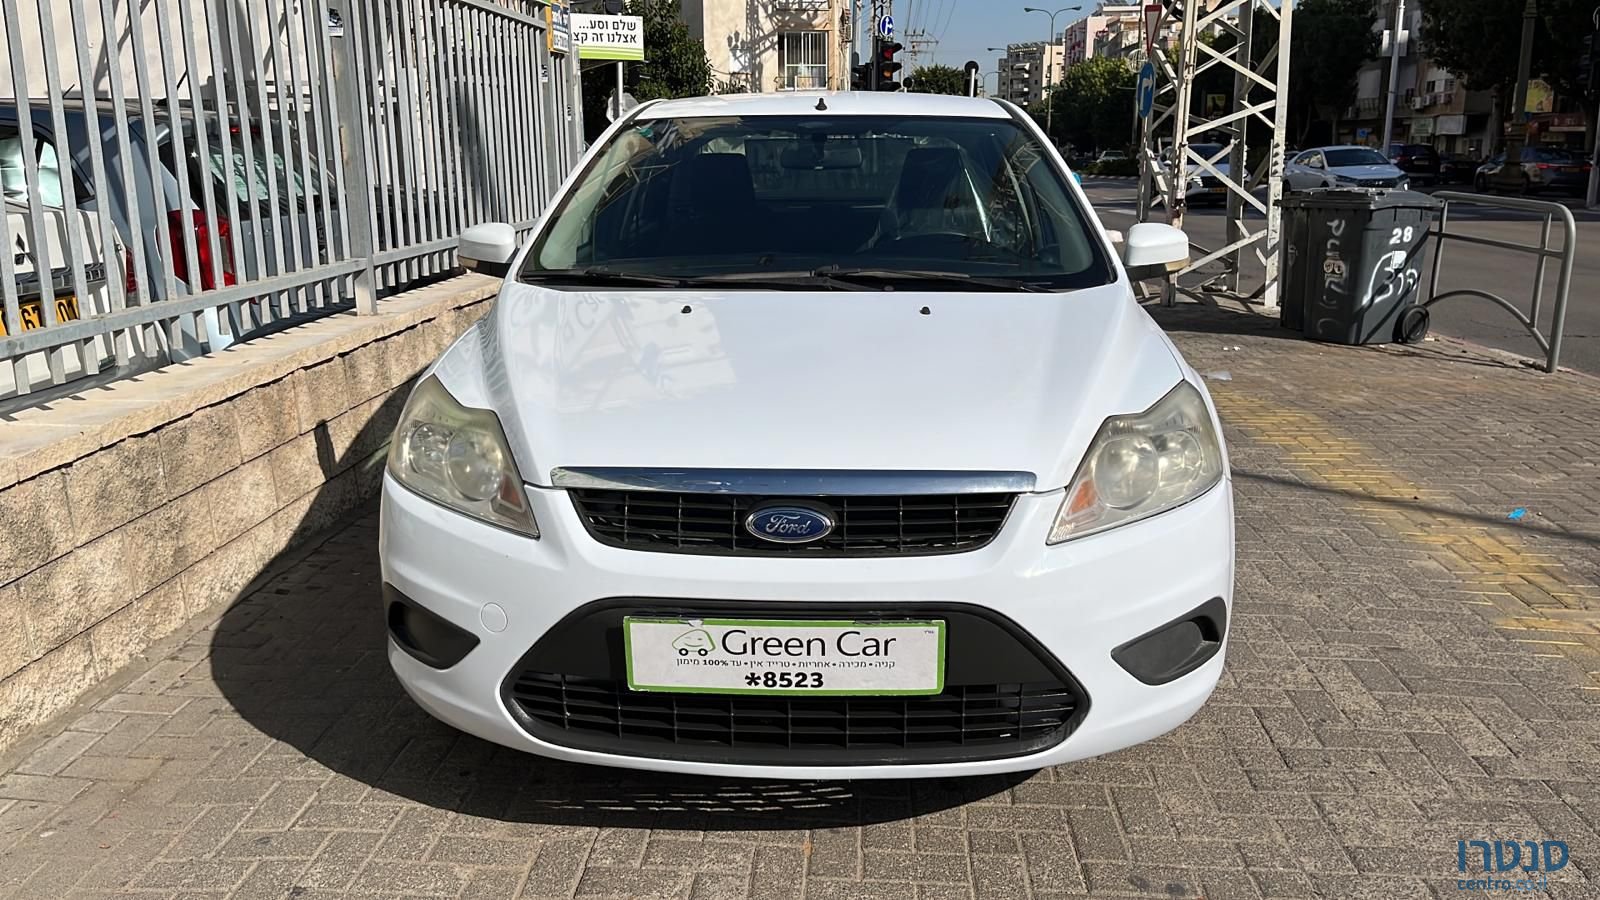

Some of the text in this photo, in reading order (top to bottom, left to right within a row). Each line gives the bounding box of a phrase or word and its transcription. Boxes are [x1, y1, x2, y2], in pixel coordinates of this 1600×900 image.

[613, 19, 636, 31] שלם
[571, 32, 588, 44] קצ
[592, 32, 604, 42] זה
[607, 31, 636, 43] אצלנו
[1389, 226, 1413, 245] 28
[765, 514, 812, 534] Ford
[722, 629, 897, 656] Green Car
[676, 658, 700, 667] מימון
[750, 660, 764, 669] אין
[873, 661, 896, 669] קניה
